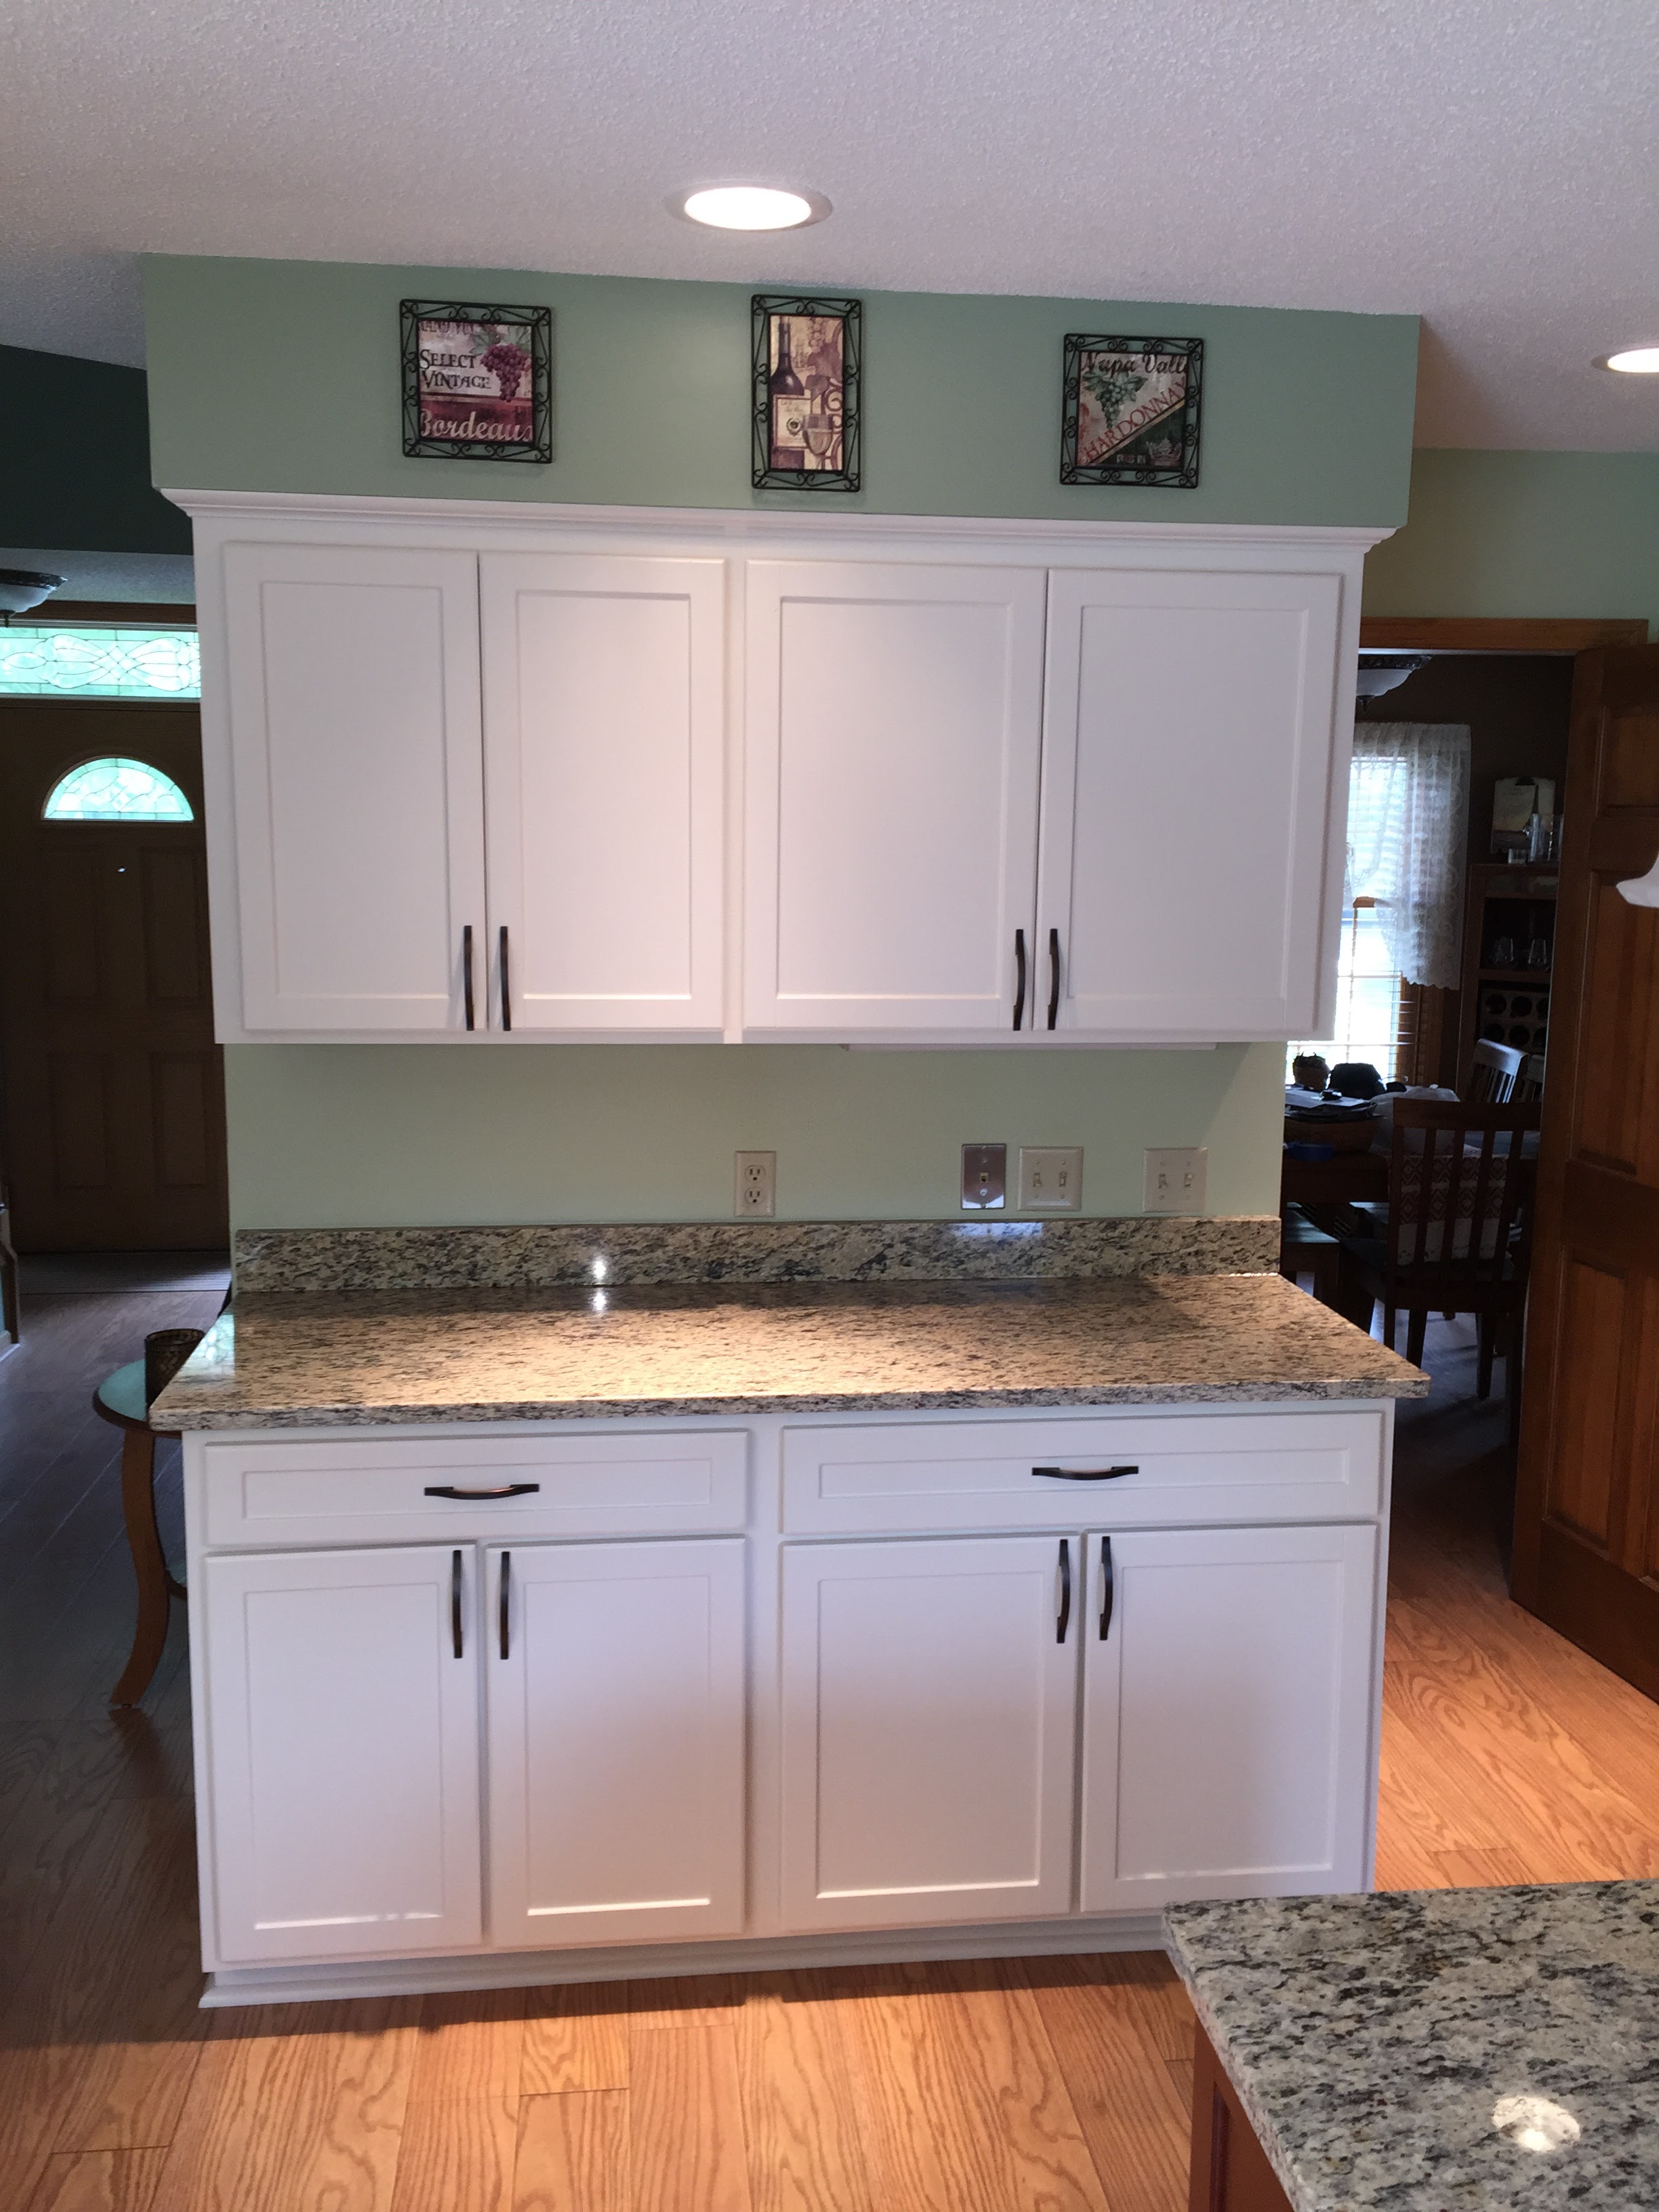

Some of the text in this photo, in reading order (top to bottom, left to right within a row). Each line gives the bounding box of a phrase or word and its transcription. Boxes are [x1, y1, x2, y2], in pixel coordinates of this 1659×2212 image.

[419, 349, 476, 371] SELECT
[1082, 352, 1187, 379] Napa Vall
[421, 371, 492, 389] VINTAGE
